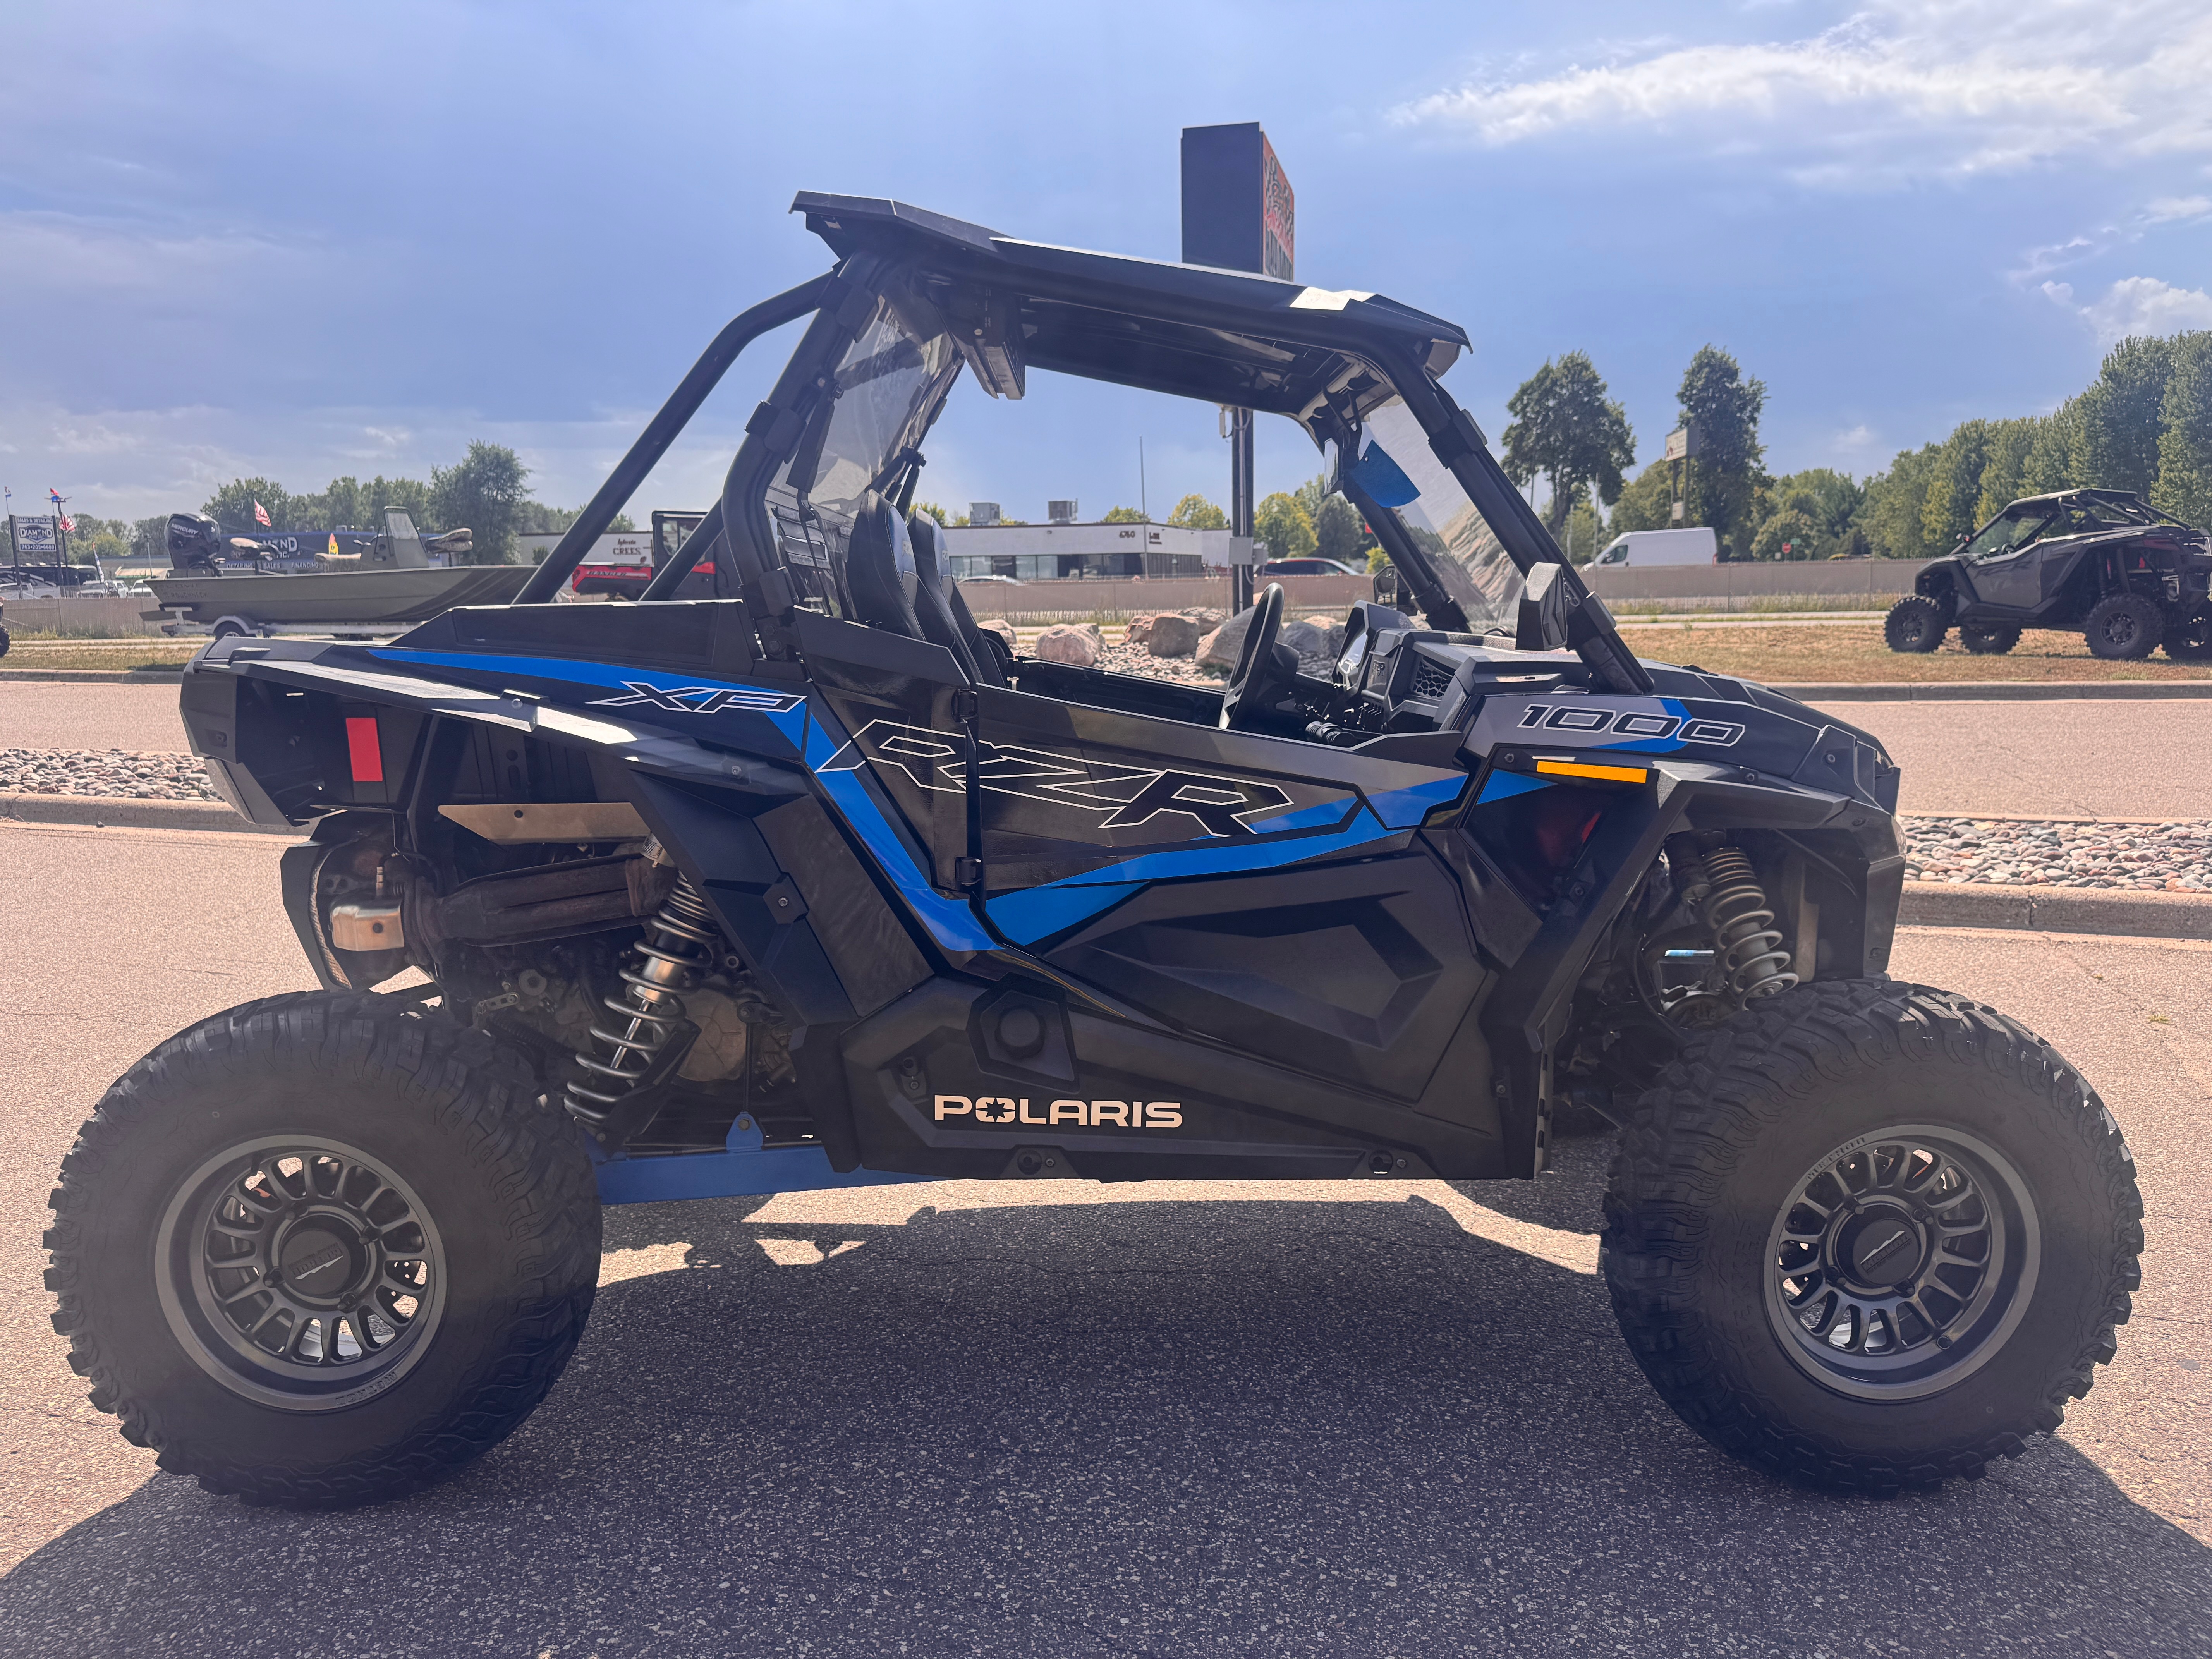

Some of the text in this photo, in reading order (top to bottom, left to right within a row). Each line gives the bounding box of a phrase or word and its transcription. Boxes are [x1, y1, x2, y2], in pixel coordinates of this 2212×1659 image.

[171, 523, 199, 534] MERCURY
[613, 547, 641, 555] CREES
[585, 681, 807, 713] XP
[1517, 704, 1745, 747] 1000
[815, 719, 1294, 836] RZR
[934, 1095, 1183, 1128] POLARIS
[335, 1371, 398, 1406] METHOD
